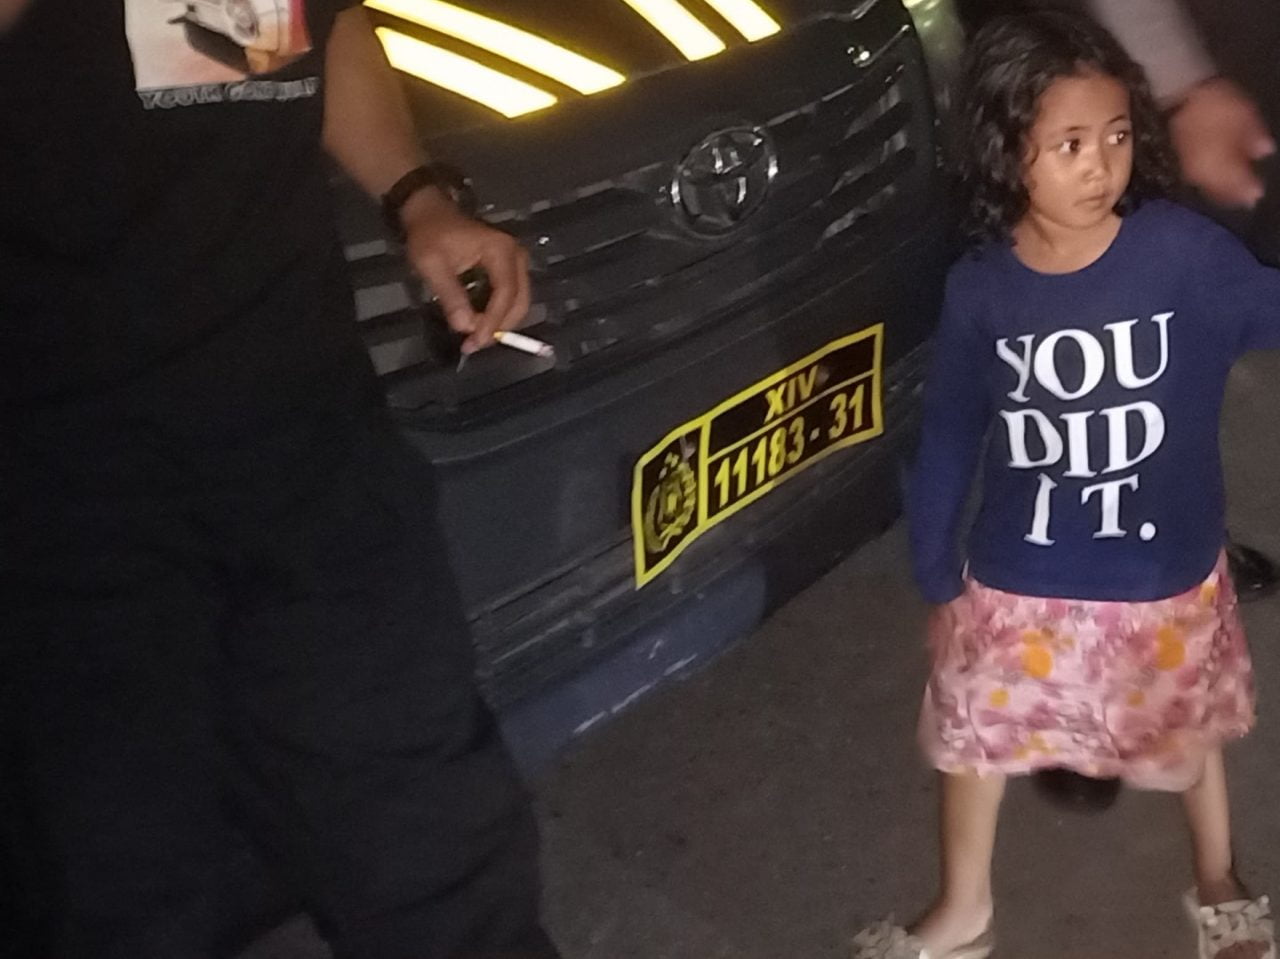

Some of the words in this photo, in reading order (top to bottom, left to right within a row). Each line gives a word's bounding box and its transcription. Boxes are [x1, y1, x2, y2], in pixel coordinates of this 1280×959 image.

[763, 365, 818, 424] XIV
[996, 311, 1175, 403] YOU
[999, 400, 1166, 478] DID
